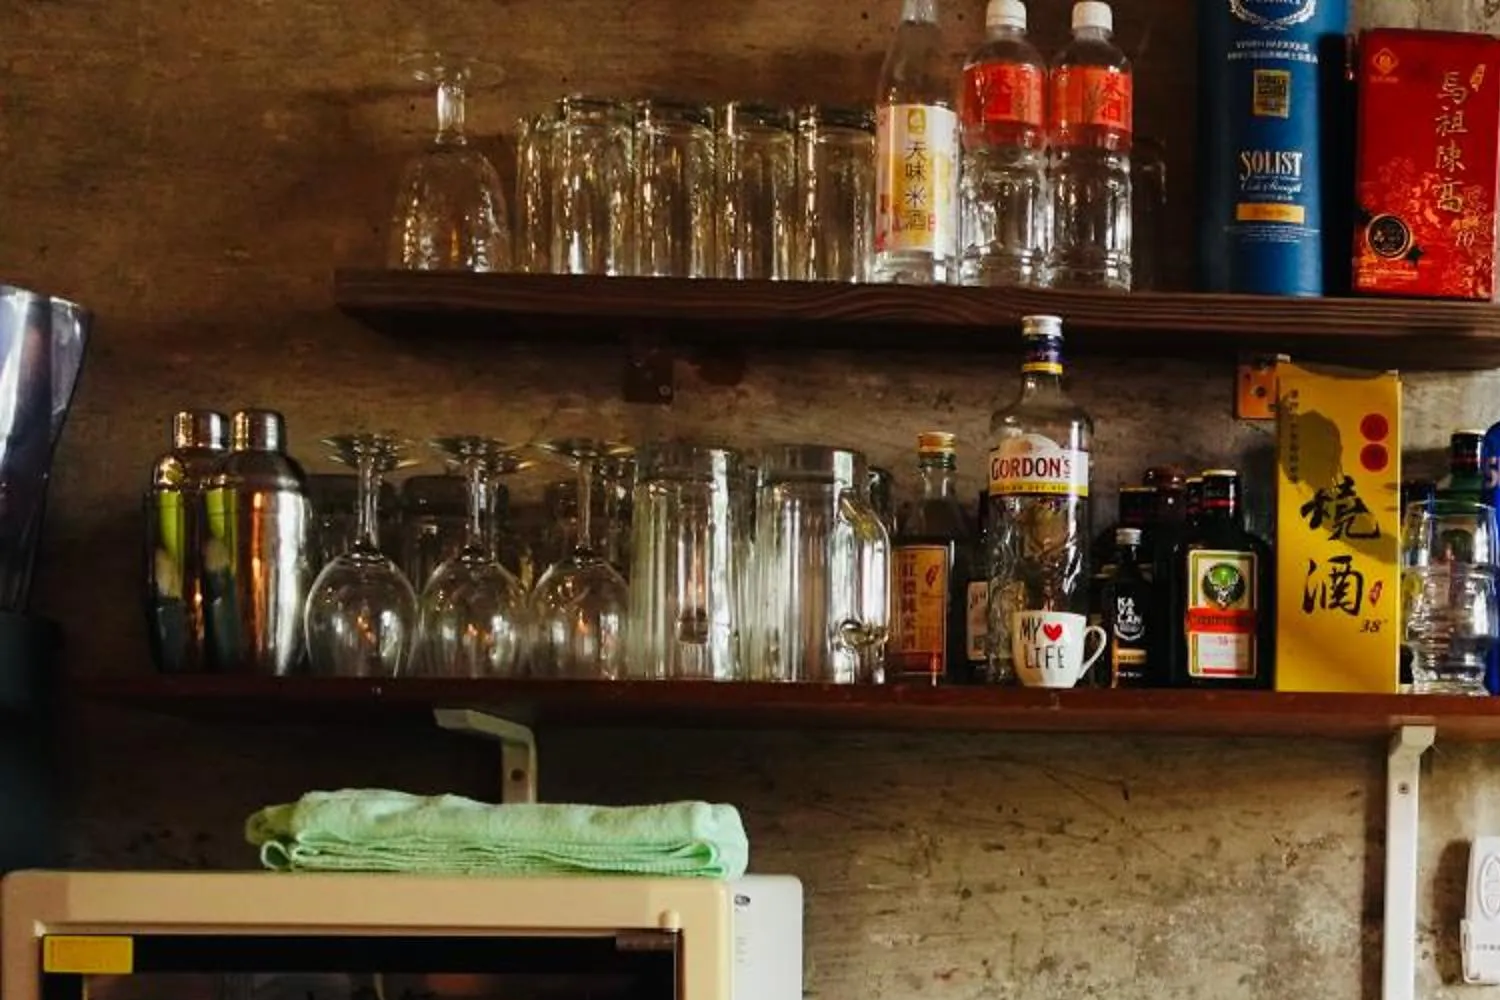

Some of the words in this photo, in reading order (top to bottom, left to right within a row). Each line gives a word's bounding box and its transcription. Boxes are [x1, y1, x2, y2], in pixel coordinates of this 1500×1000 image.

[1240, 150, 1303, 182] SOLIST
[991, 456, 1071, 480] GORDON'S
[1020, 616, 1042, 642] MY
[1024, 644, 1065, 669] LIFE
